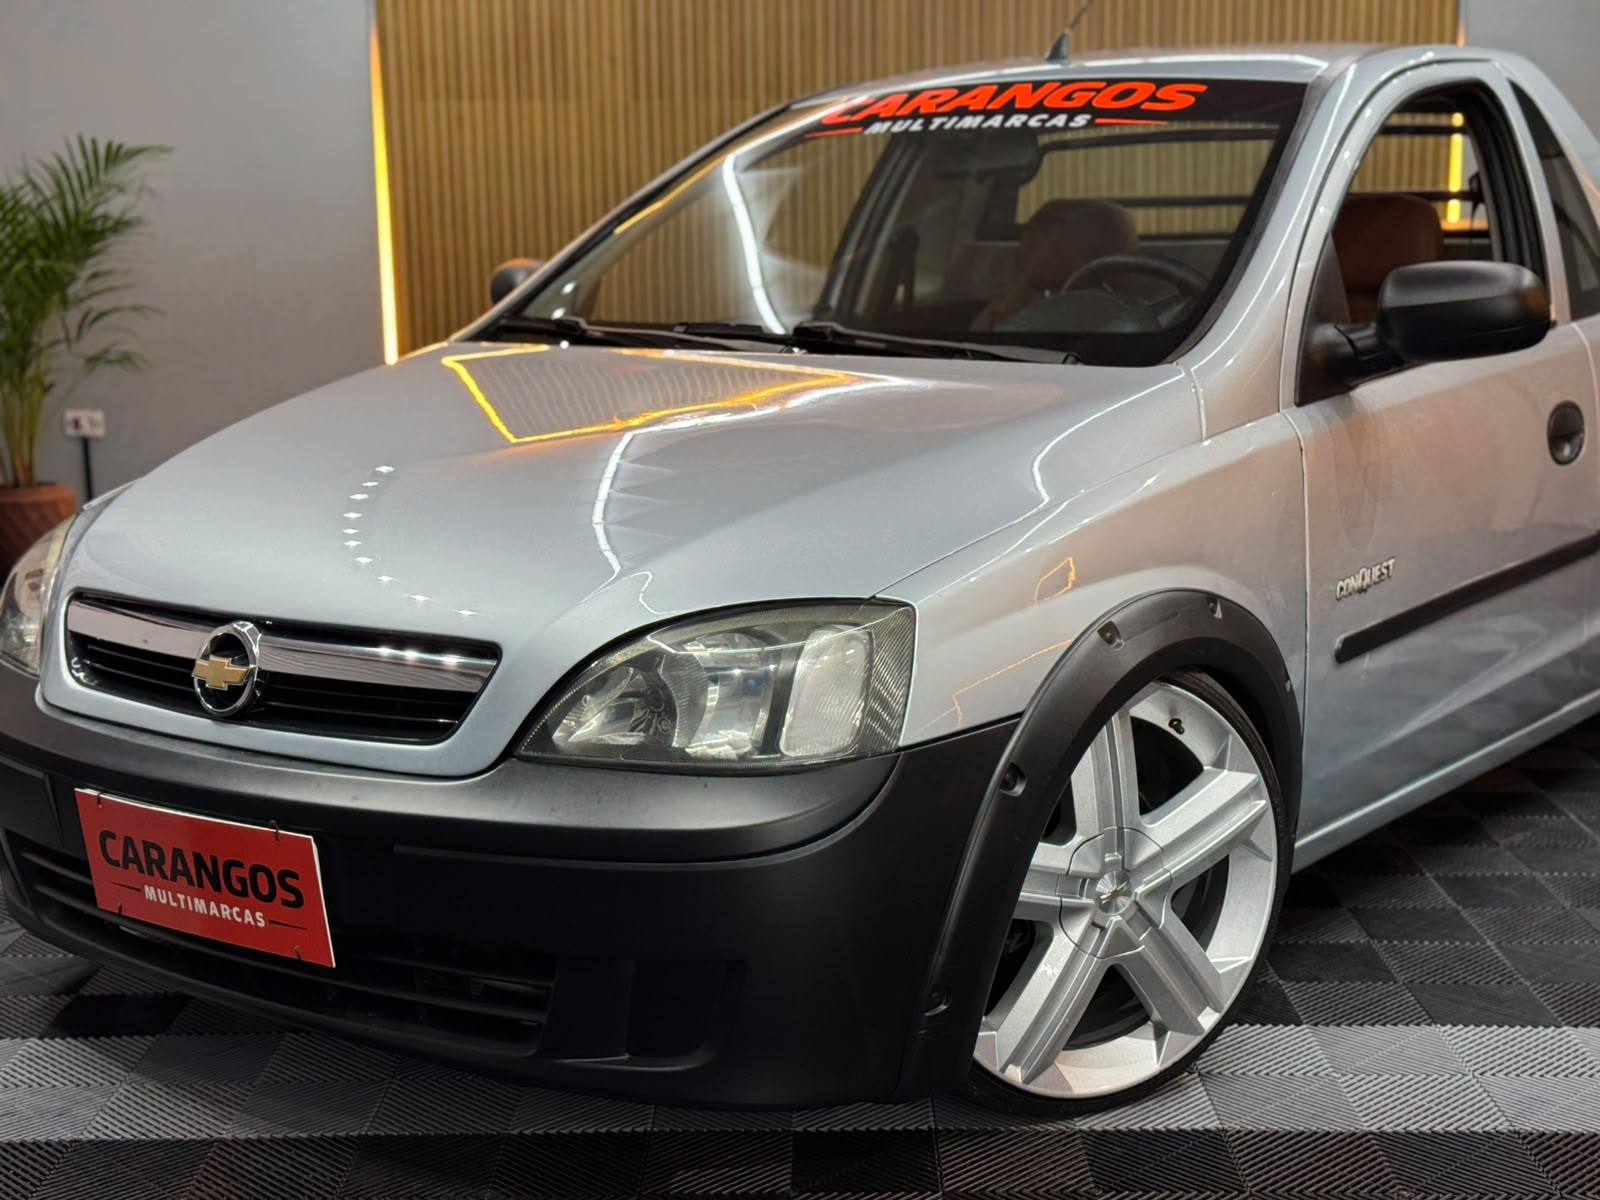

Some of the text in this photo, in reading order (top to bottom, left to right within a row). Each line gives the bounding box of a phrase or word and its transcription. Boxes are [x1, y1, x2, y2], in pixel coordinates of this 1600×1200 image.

[820, 81, 1207, 124] CARANGOS
[863, 113, 1093, 135] MULTIMARCAS
[1336, 557, 1395, 600] CONQUEST
[99, 829, 304, 909] CARANGOS
[143, 884, 266, 927] MULTIMARCAS
